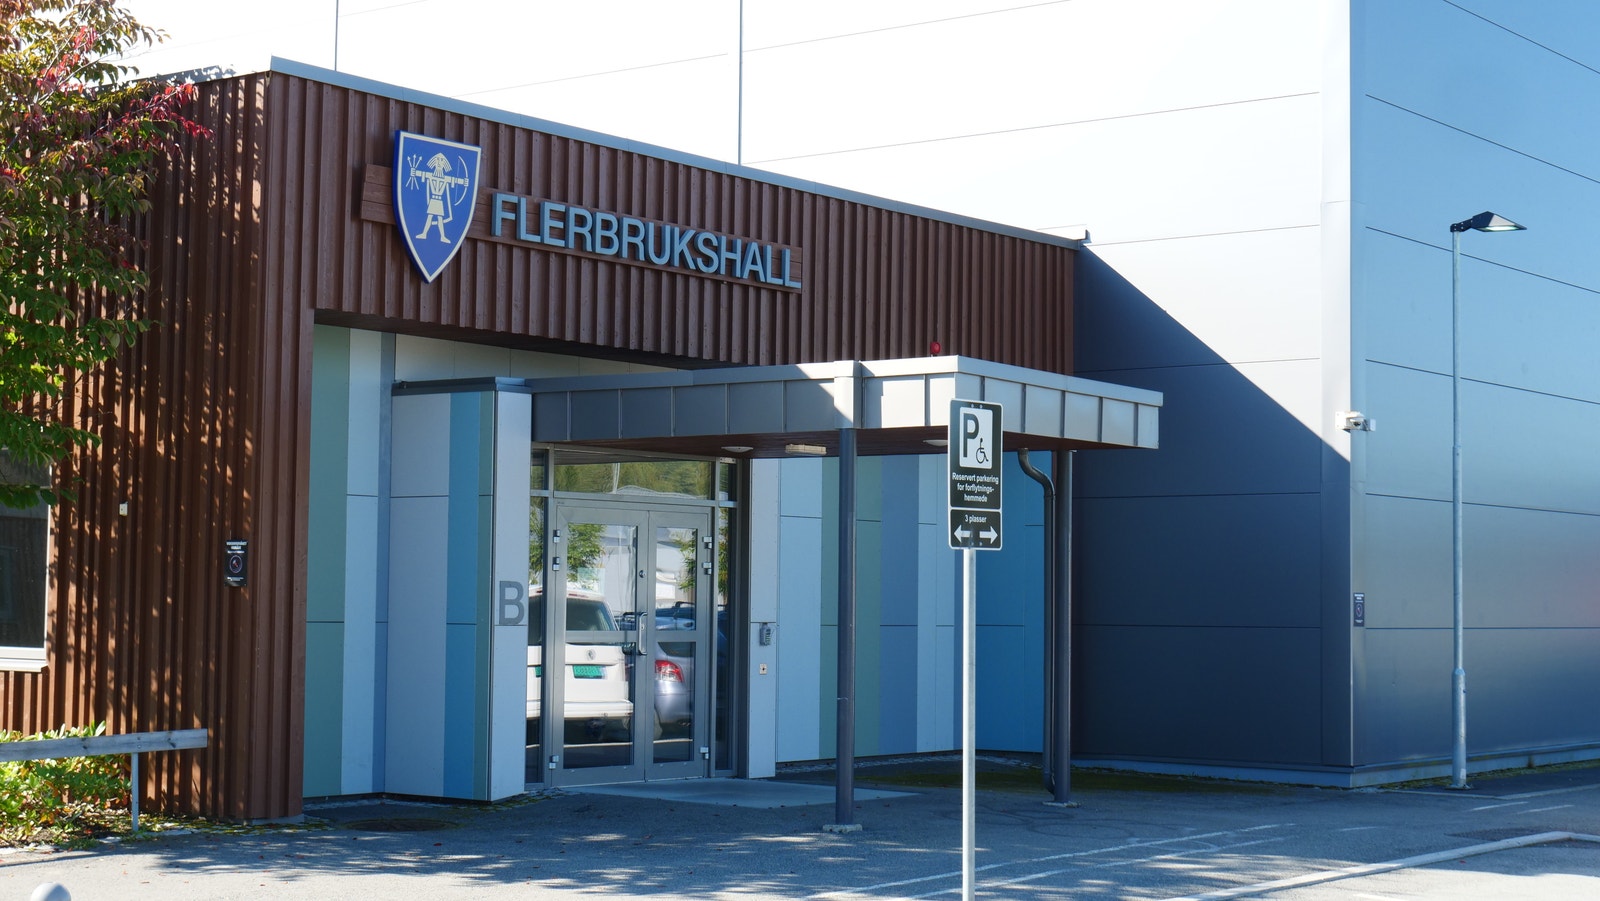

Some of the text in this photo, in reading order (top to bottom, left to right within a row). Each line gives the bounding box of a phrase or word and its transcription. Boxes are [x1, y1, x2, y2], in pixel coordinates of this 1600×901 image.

[490, 192, 802, 289] FLERBRUKSHALL
[963, 412, 980, 458] P
[952, 472, 999, 485] Reservert parkering
[957, 482, 994, 494] for forflytnings-
[964, 493, 988, 502] hemmede
[965, 514, 987, 524] 3 plasser
[499, 580, 525, 625] B
